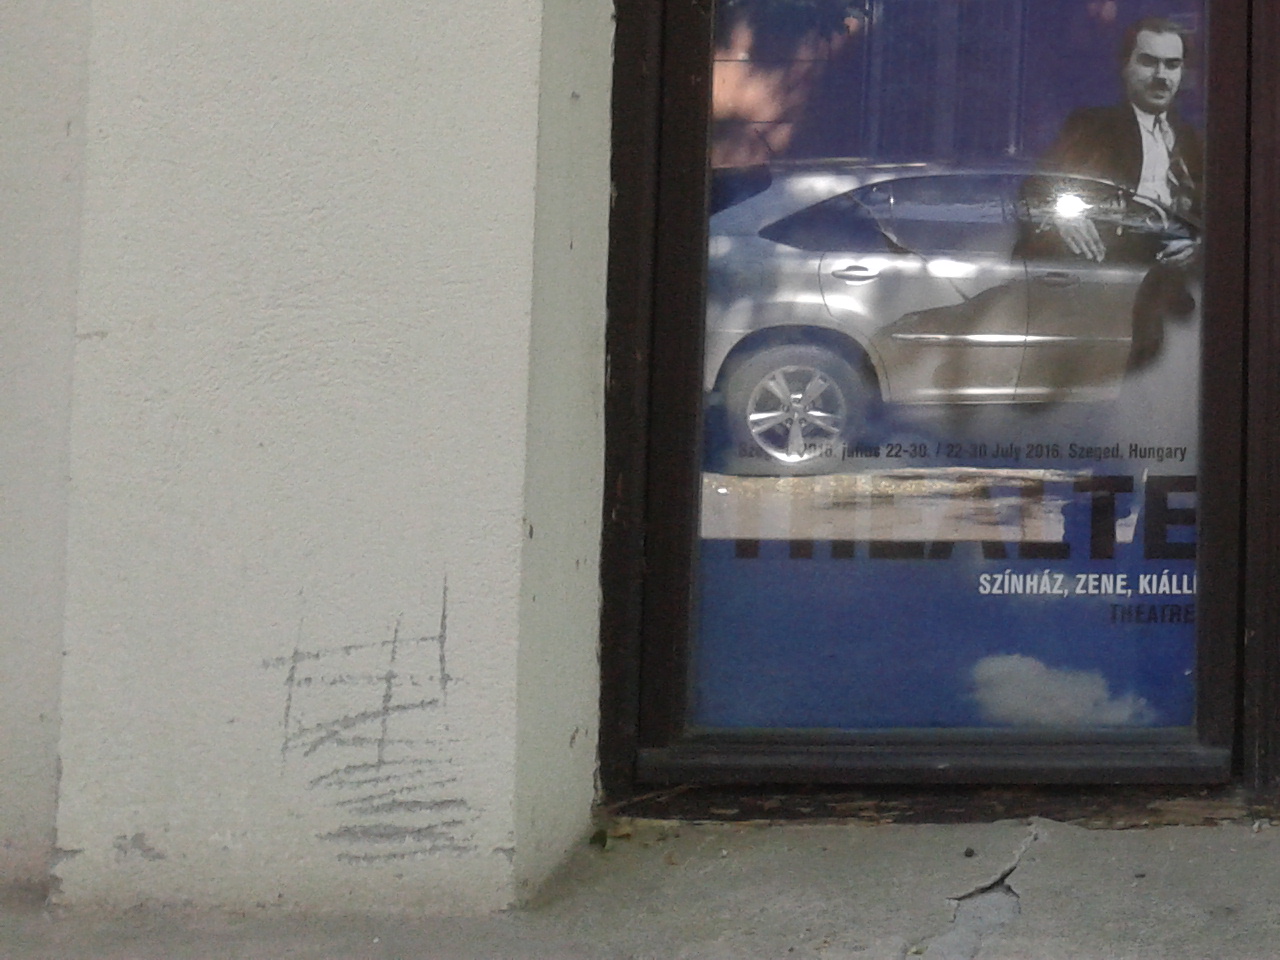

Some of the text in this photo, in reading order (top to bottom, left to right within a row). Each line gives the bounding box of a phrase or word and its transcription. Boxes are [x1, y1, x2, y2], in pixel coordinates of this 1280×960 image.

[1128, 442, 1187, 462] Hungary
[979, 569, 1069, 598] SZÍNHÁZ,
[1075, 573, 1132, 598] ZENE,
